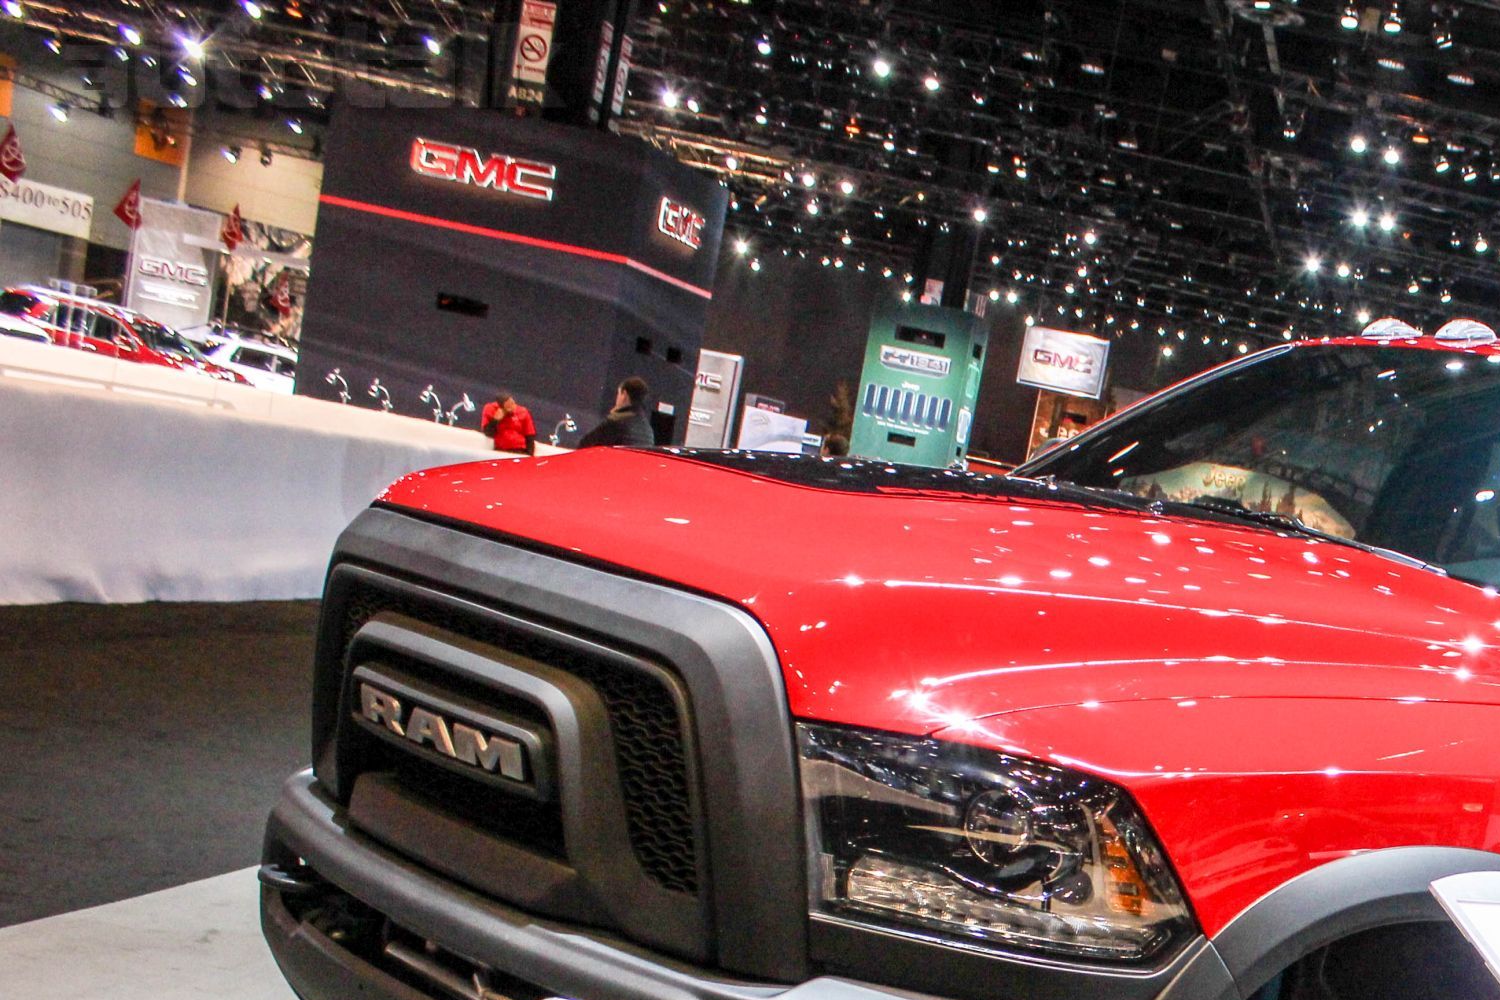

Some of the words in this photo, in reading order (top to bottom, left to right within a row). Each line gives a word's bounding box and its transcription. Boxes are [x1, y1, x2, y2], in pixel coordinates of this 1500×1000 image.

[410, 137, 556, 200] GMC
[658, 196, 706, 250] GMC
[139, 256, 208, 287] GMC
[1033, 348, 1092, 375] GMC
[1202, 464, 1247, 490] Jeep
[361, 682, 524, 781] RAM
